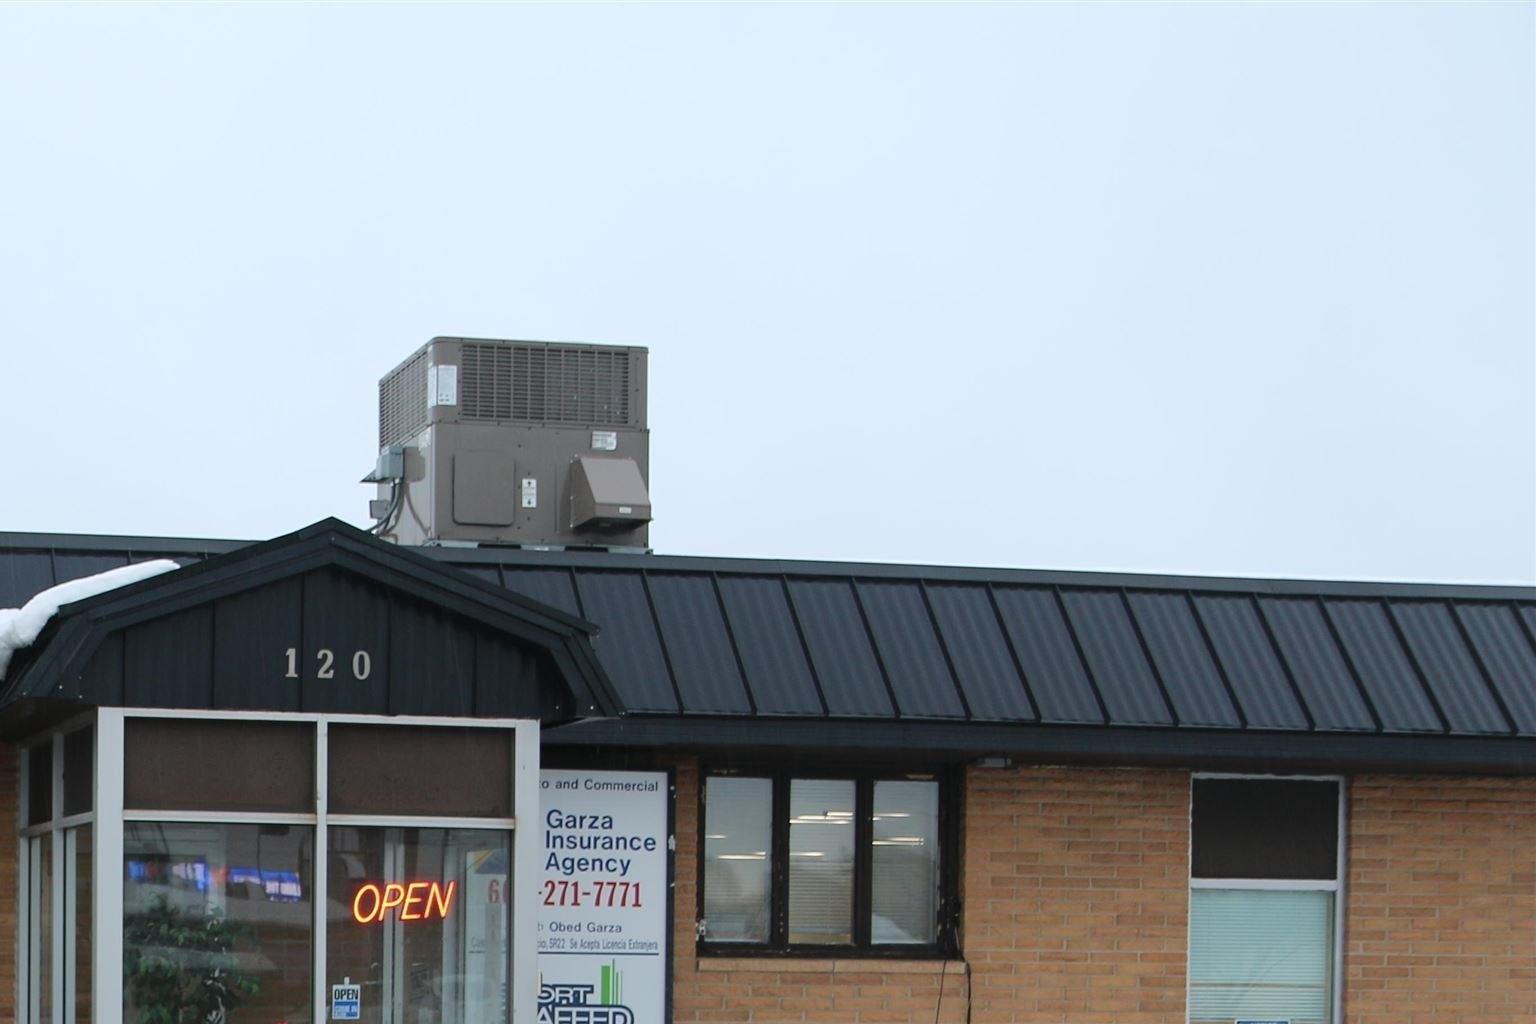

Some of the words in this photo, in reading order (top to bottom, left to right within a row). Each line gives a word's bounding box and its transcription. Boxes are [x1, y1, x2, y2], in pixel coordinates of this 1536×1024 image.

[284, 647, 371, 681] 120
[555, 779, 579, 790] and
[584, 779, 659, 792] Commercial
[546, 809, 614, 830] Garza
[545, 830, 657, 852] Insurance
[545, 852, 632, 876] Agency
[353, 880, 455, 924] OPEN
[549, 921, 582, 933] Obed
[586, 921, 623, 934] Garza
[334, 988, 359, 1001] OPEN
